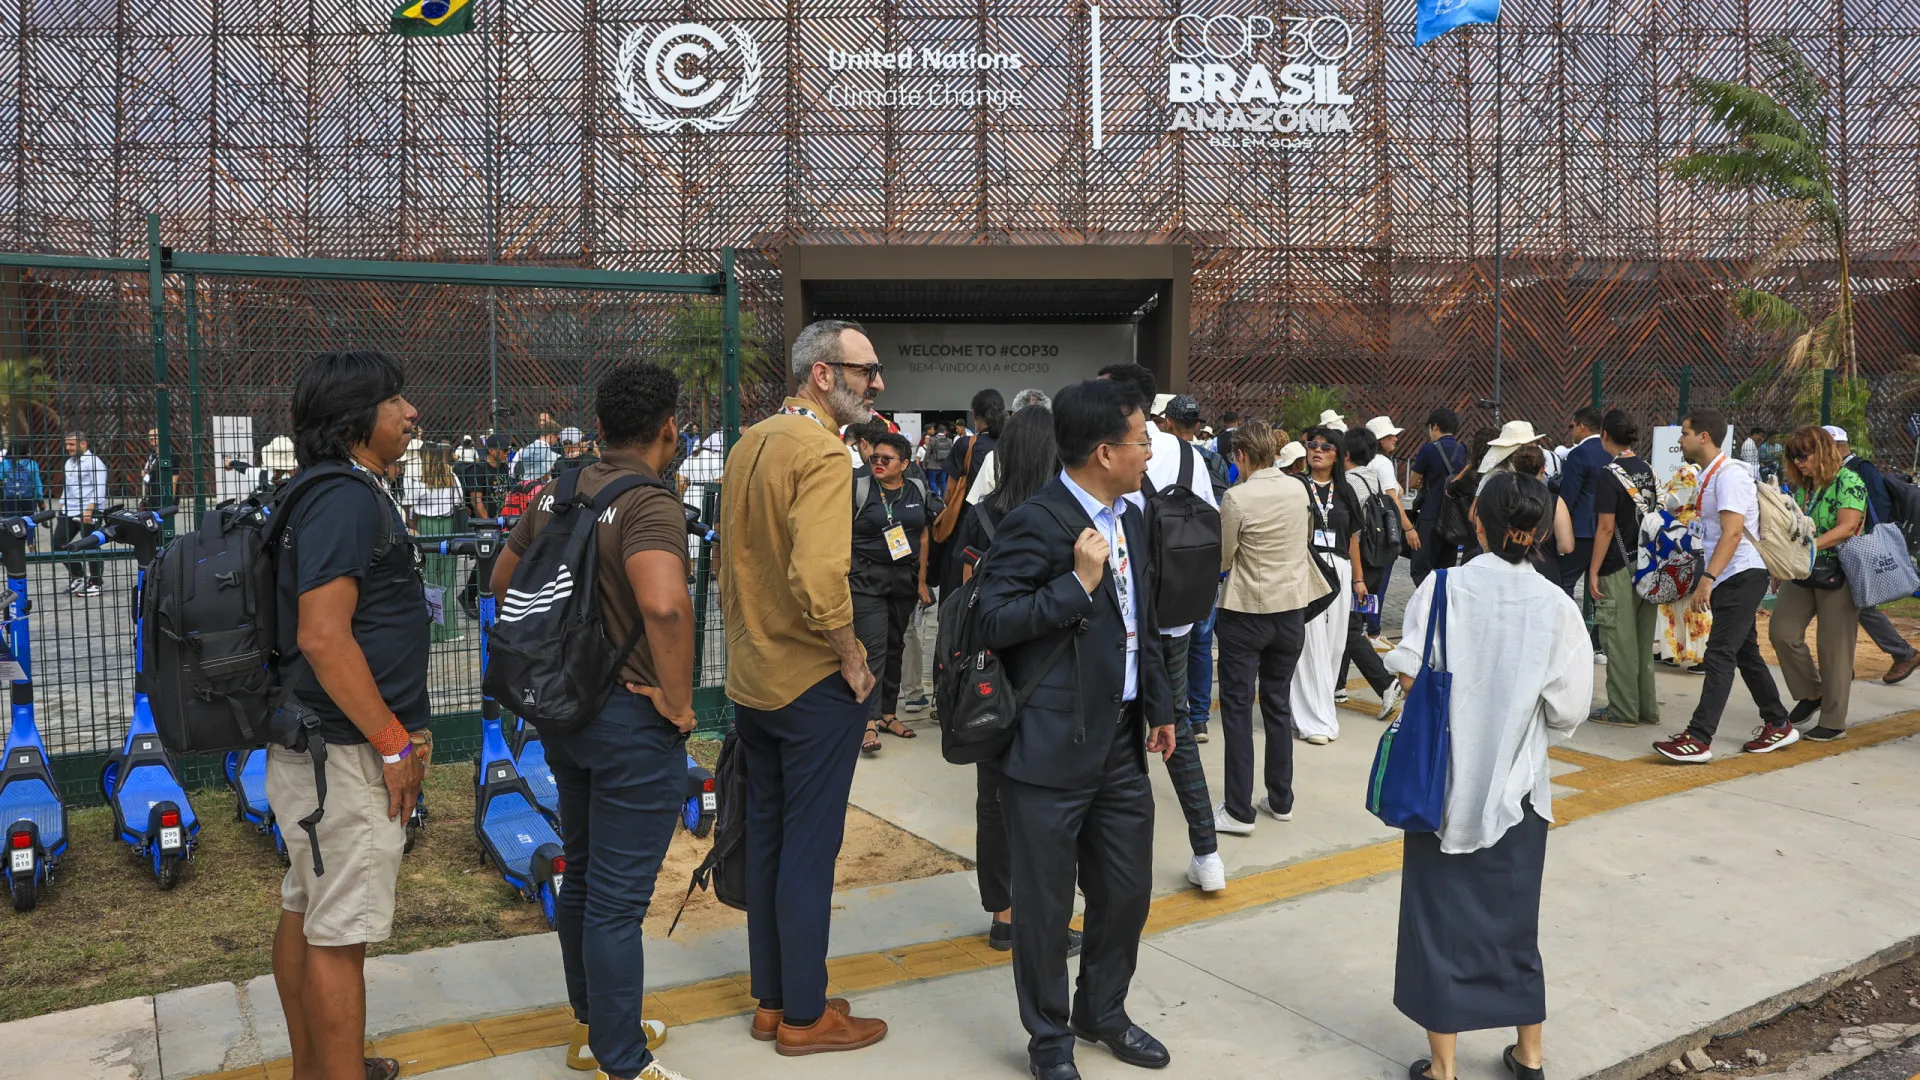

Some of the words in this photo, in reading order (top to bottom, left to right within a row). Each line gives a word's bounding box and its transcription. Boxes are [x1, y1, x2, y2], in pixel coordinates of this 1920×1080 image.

[828, 48, 914, 70] United
[921, 48, 1022, 70] Nations
[1169, 63, 1354, 104] BRASIL
[829, 84, 921, 107] Climate
[929, 83, 1022, 112] Change
[1169, 103, 1353, 133] AMAZÔNIA
[898, 344, 973, 357] WELCOME
[976, 344, 997, 357] TO
[1000, 344, 1059, 357] #COP30
[909, 362, 991, 374] BEM-VINDO(A)
[992, 363, 1001, 373] A
[1004, 362, 1049, 373] #COP30
